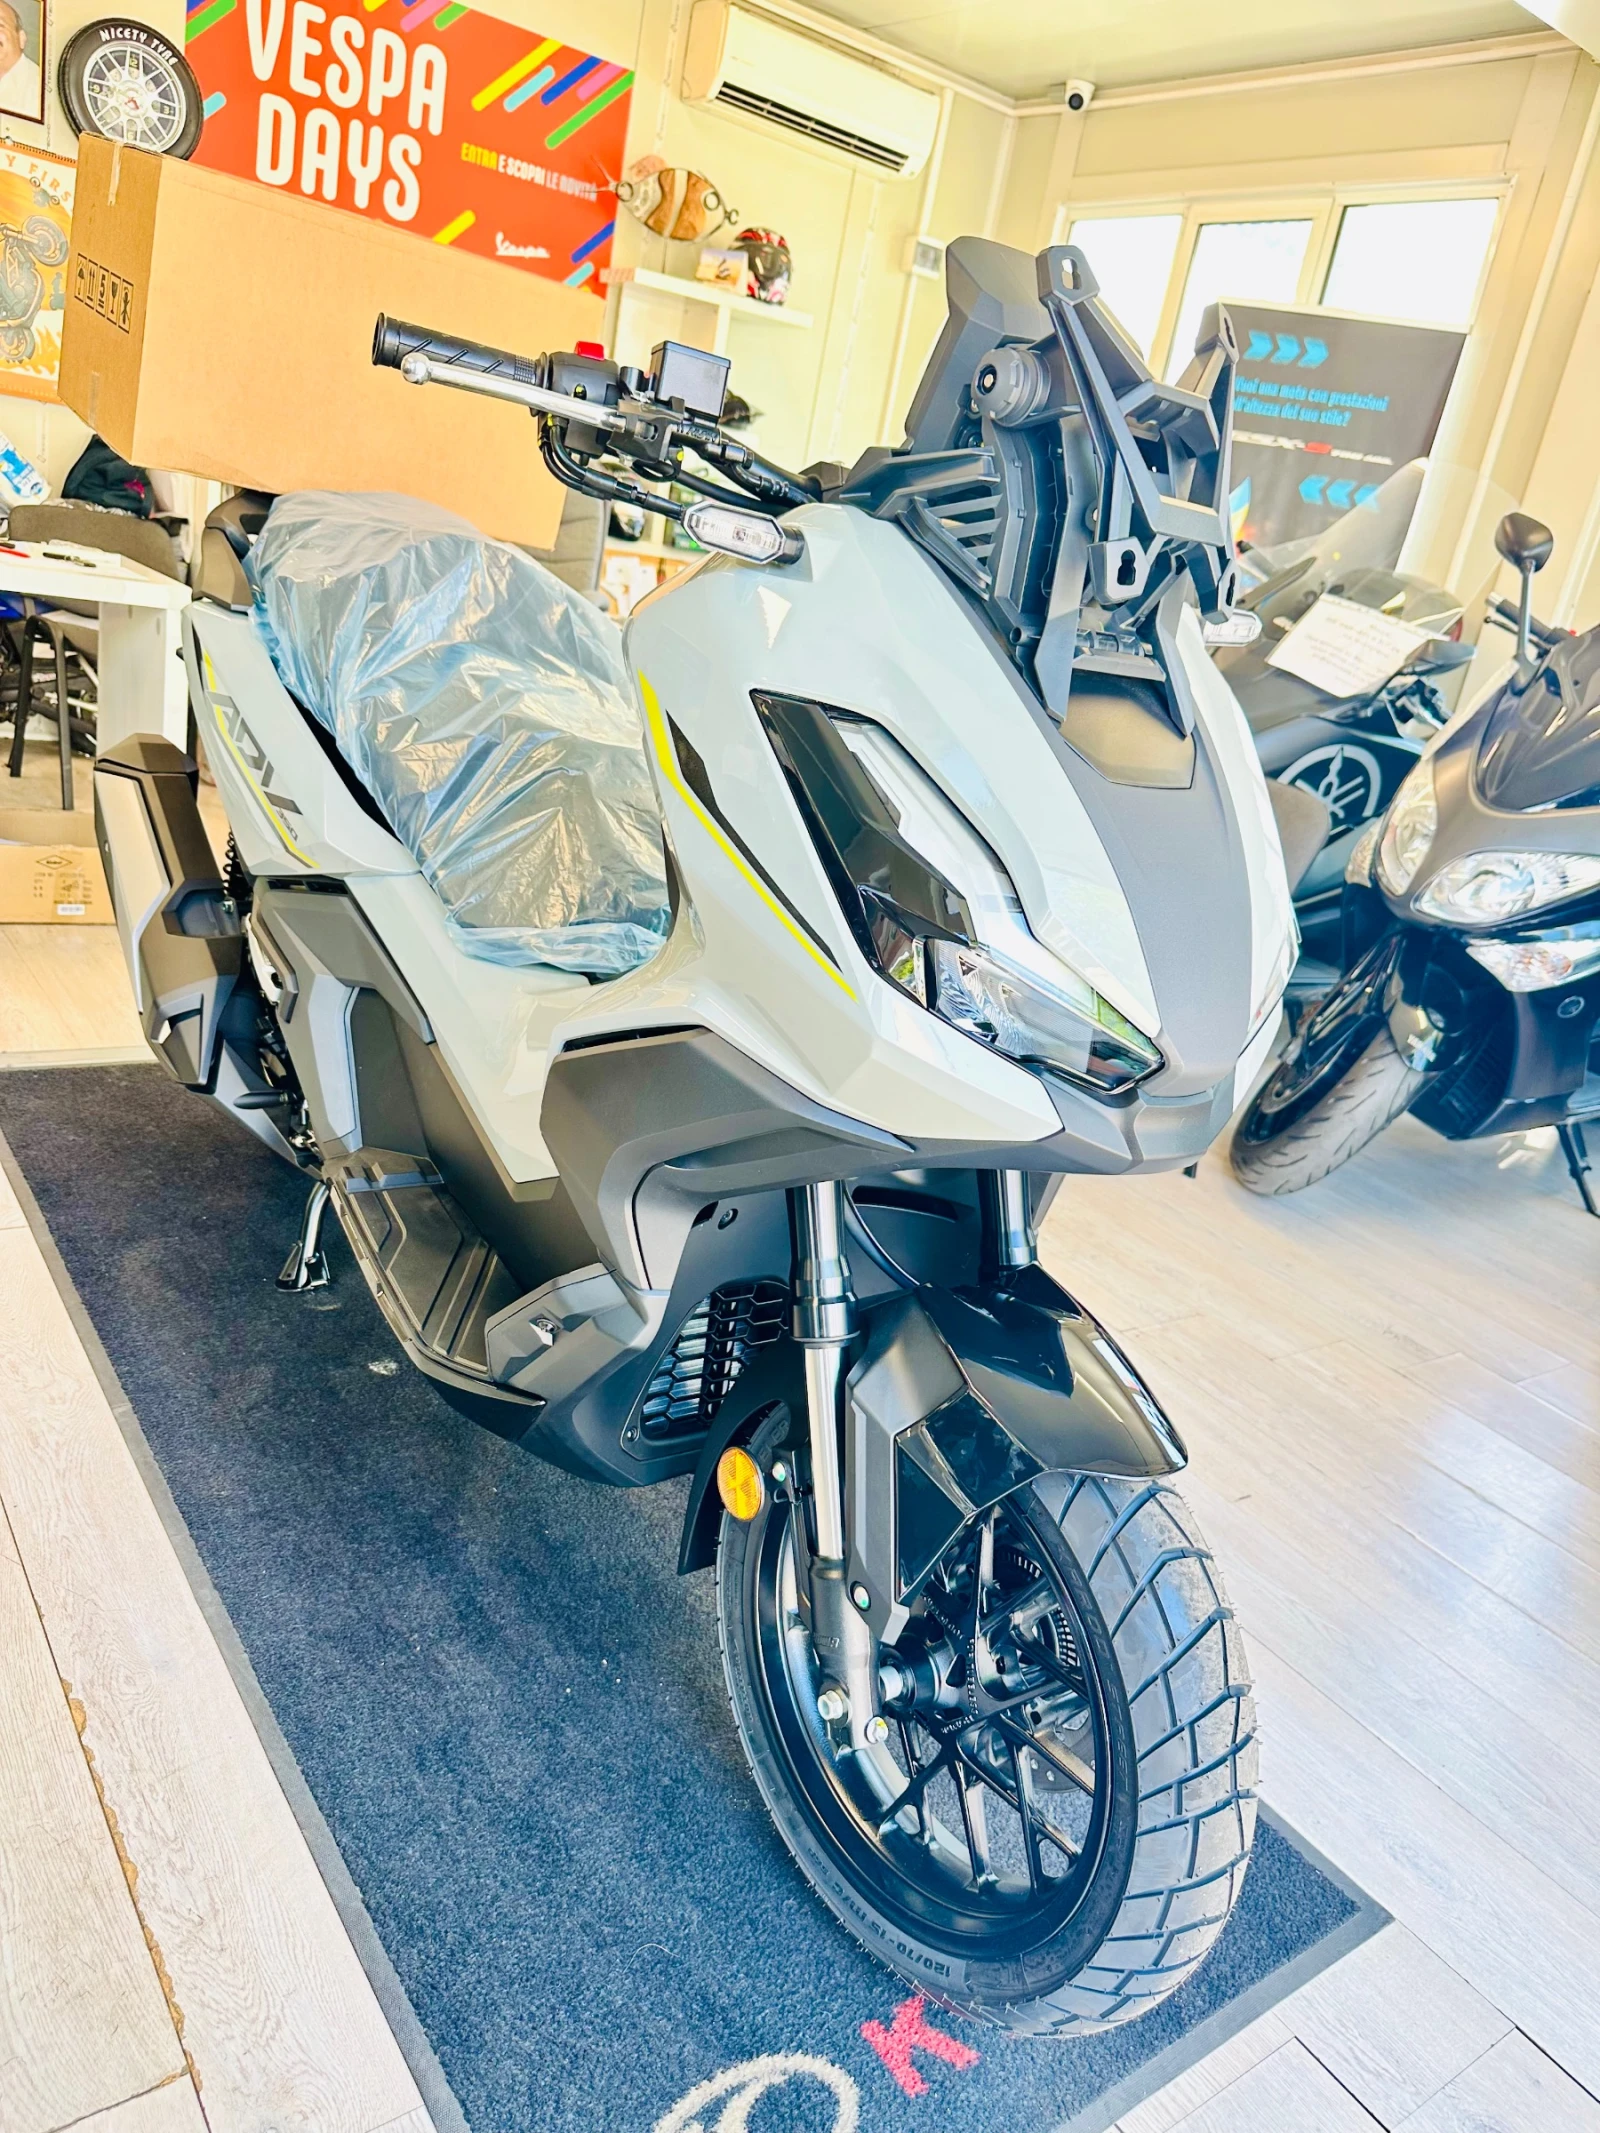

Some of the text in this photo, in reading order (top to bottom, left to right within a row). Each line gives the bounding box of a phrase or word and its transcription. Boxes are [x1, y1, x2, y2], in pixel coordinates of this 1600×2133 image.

[98, 26, 179, 66] NICETY TYRE
[245, 0, 448, 136] VESPA
[256, 92, 422, 222] DAYS
[461, 142, 498, 170] ENTRA
[498, 154, 506, 173] E
[506, 157, 546, 186] SCOPRI
[546, 170, 559, 191] LE
[28, 162, 73, 205] FIRS
[1233, 395, 1281, 417] ll'altezza
[1328, 390, 1390, 412] prestazioni
[275, 808, 299, 842] 350
